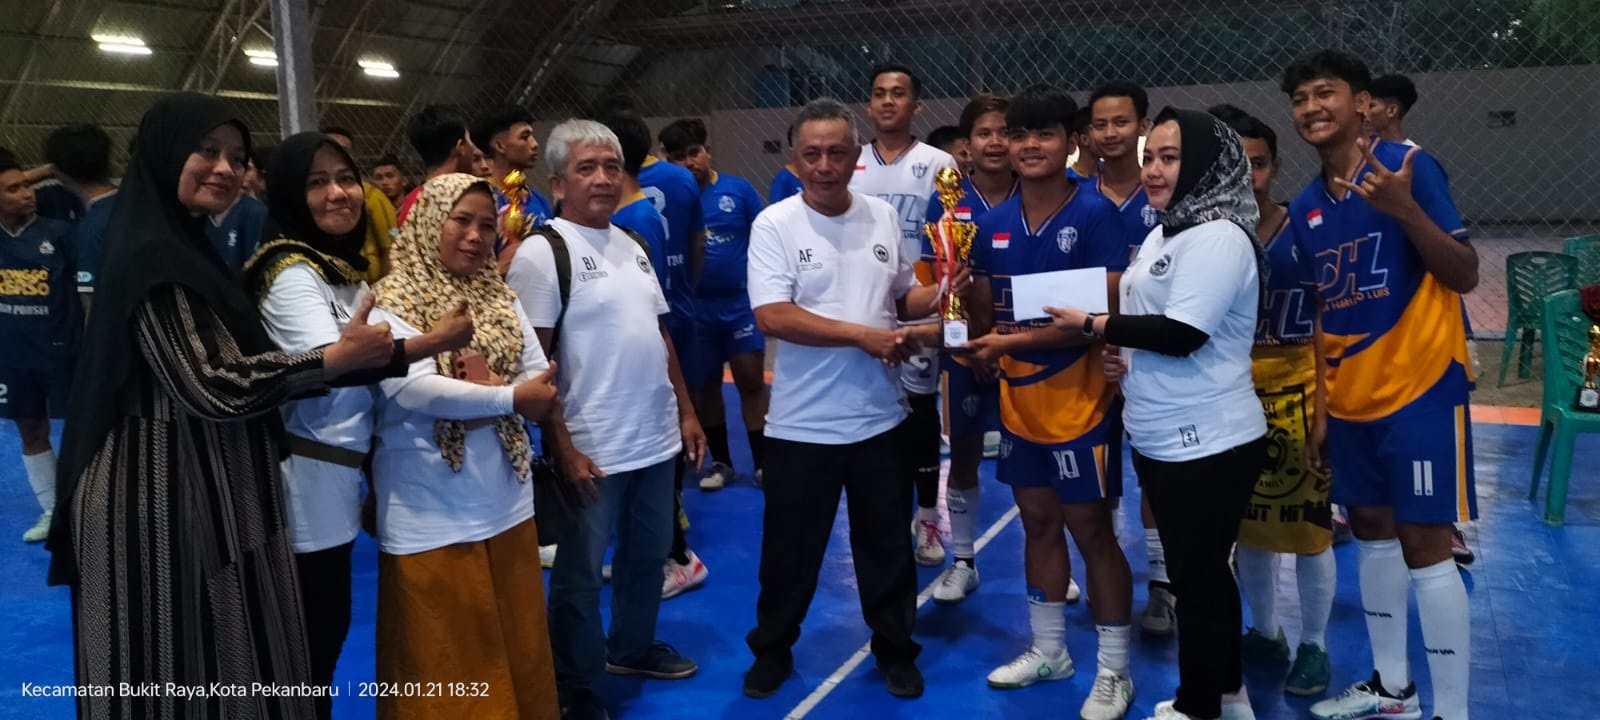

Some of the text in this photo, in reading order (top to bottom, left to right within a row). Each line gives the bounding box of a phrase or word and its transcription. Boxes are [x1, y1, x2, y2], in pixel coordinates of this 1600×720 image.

[799, 249, 813, 263] AF
[1052, 449, 1080, 480] 10
[1412, 460, 1433, 496] 11
